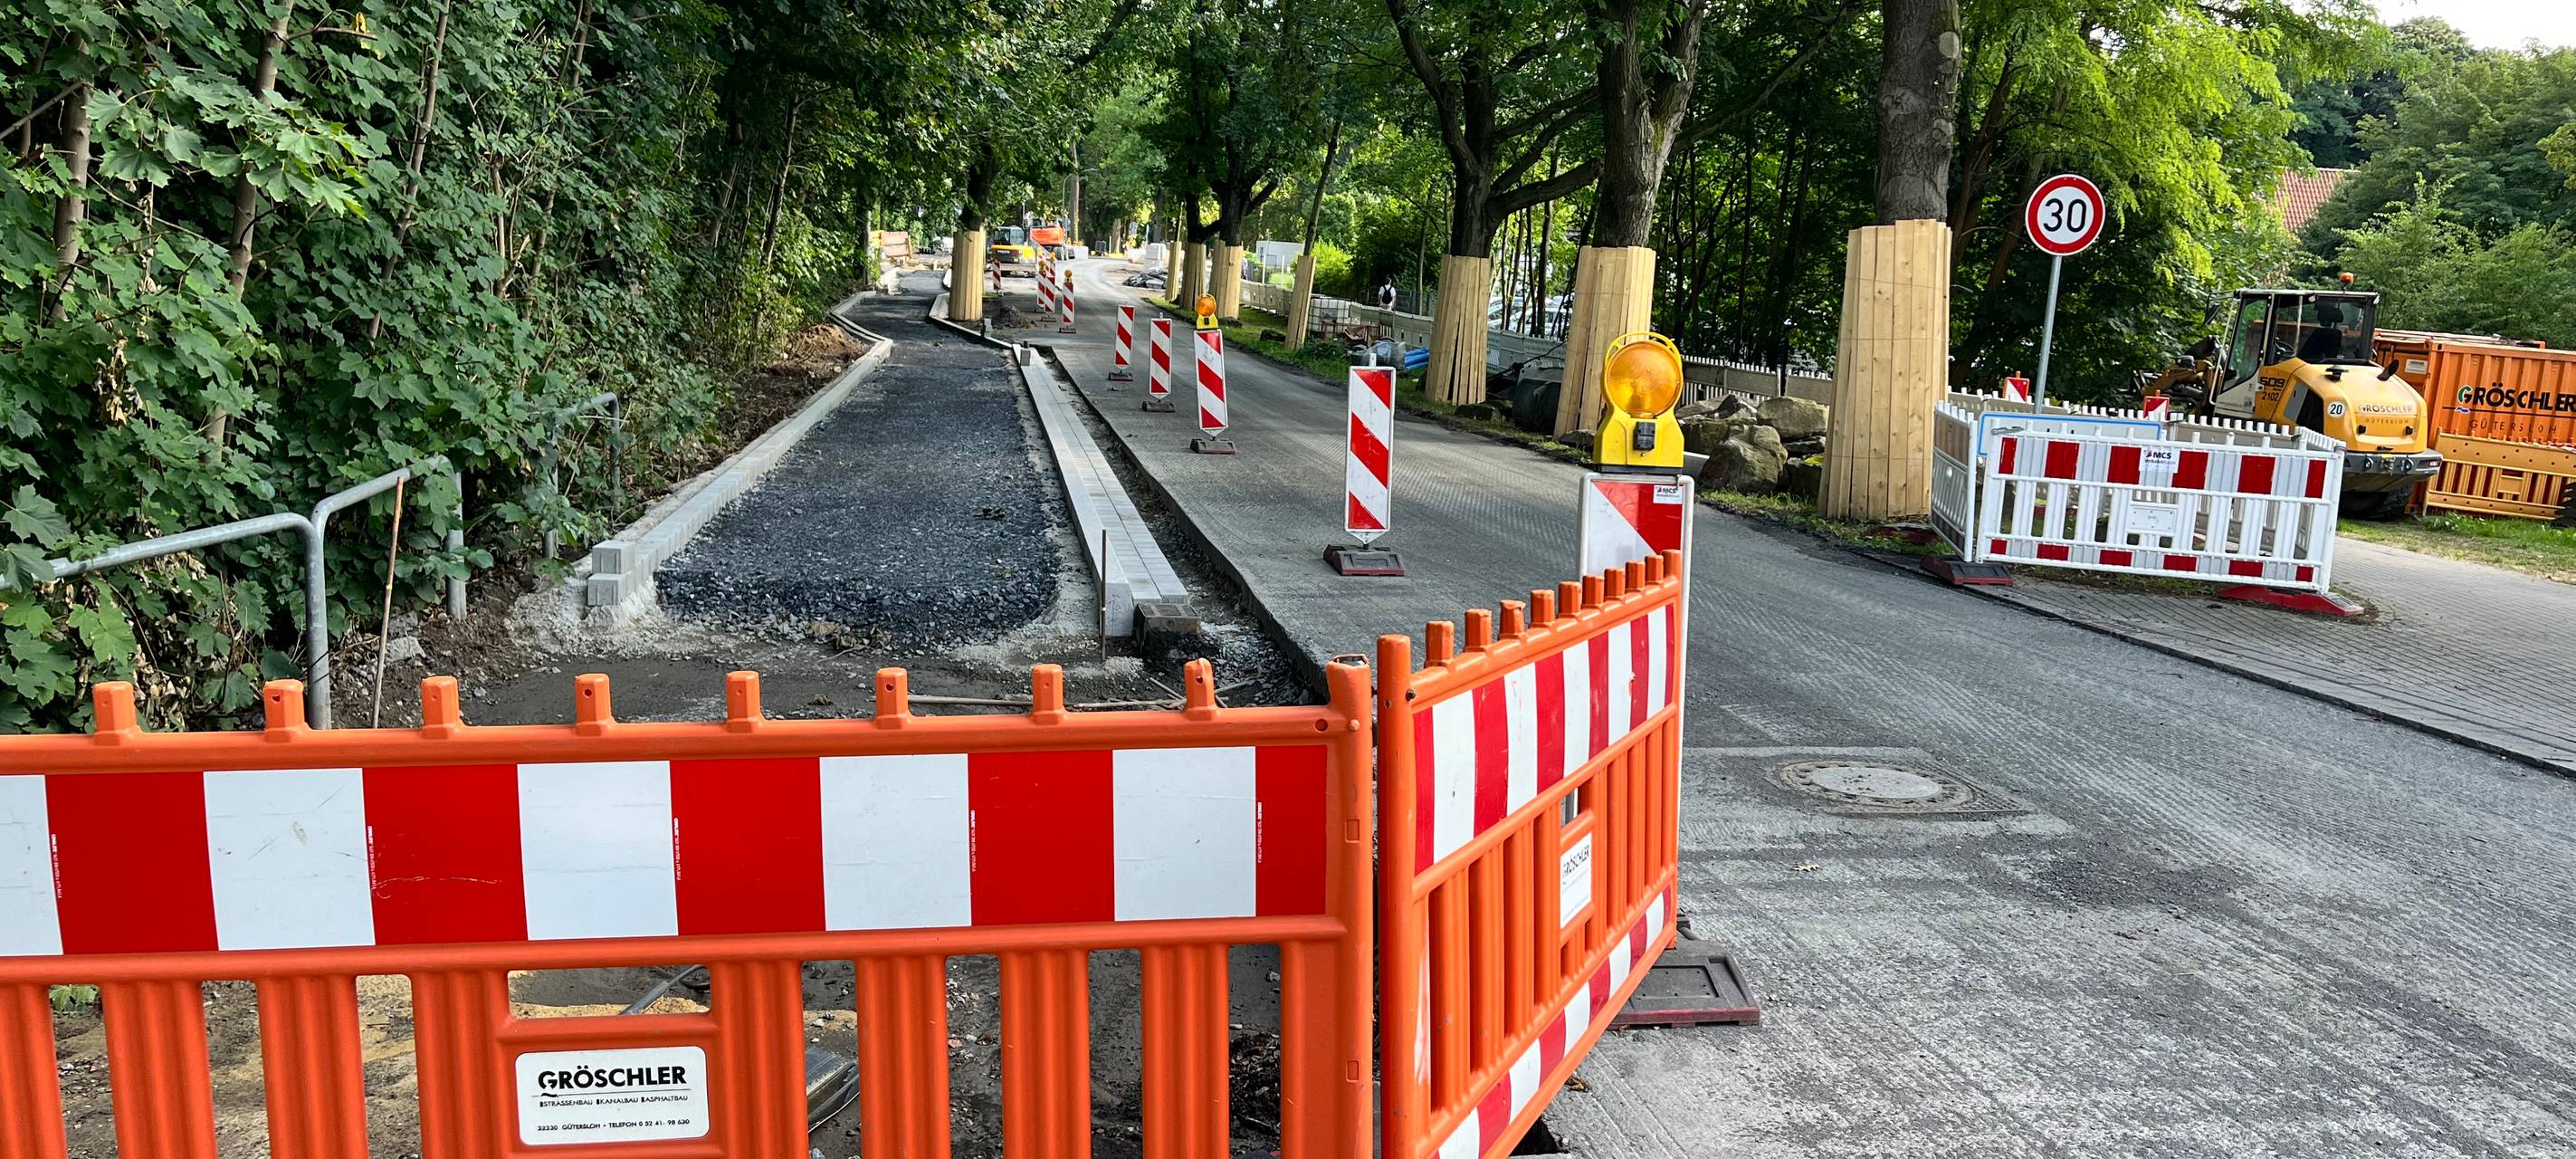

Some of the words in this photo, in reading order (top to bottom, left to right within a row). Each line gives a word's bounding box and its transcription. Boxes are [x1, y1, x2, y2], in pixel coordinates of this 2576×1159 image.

[2043, 197, 2086, 233] 30
[2262, 391, 2279, 402] 2102
[2457, 381, 2576, 413] GRÖSCHLER
[2330, 404, 2342, 415] 20
[2152, 451, 2171, 459] MCS
[538, 1065, 687, 1090] GRÖSCHLER
[542, 1099, 593, 1107] STRASSENBAU
[599, 1097, 639, 1105] KANALBAU
[645, 1095, 688, 1103] ASPHALTBAU
